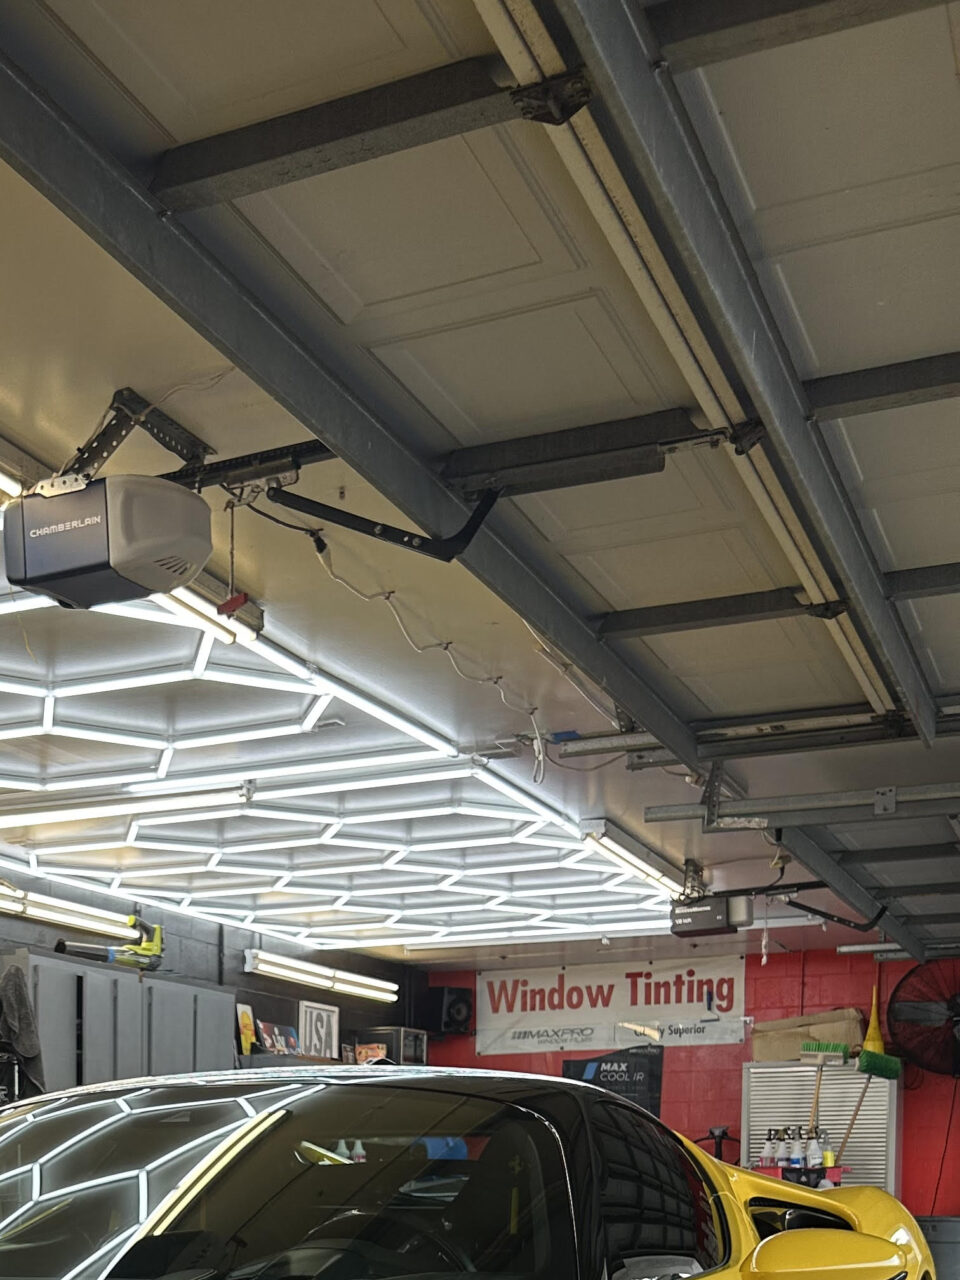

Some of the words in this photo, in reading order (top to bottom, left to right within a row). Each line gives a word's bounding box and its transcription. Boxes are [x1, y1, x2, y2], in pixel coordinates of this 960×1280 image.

[29, 515, 101, 538] CHAMBERLAIN
[486, 973, 615, 1014] Window
[625, 968, 735, 1013] Tinting
[304, 1009, 334, 1058] USA
[668, 1023, 706, 1038] Superior
[599, 1071, 631, 1081] COOL
[632, 1071, 645, 1081] IR
[600, 1061, 628, 1072] MAX
